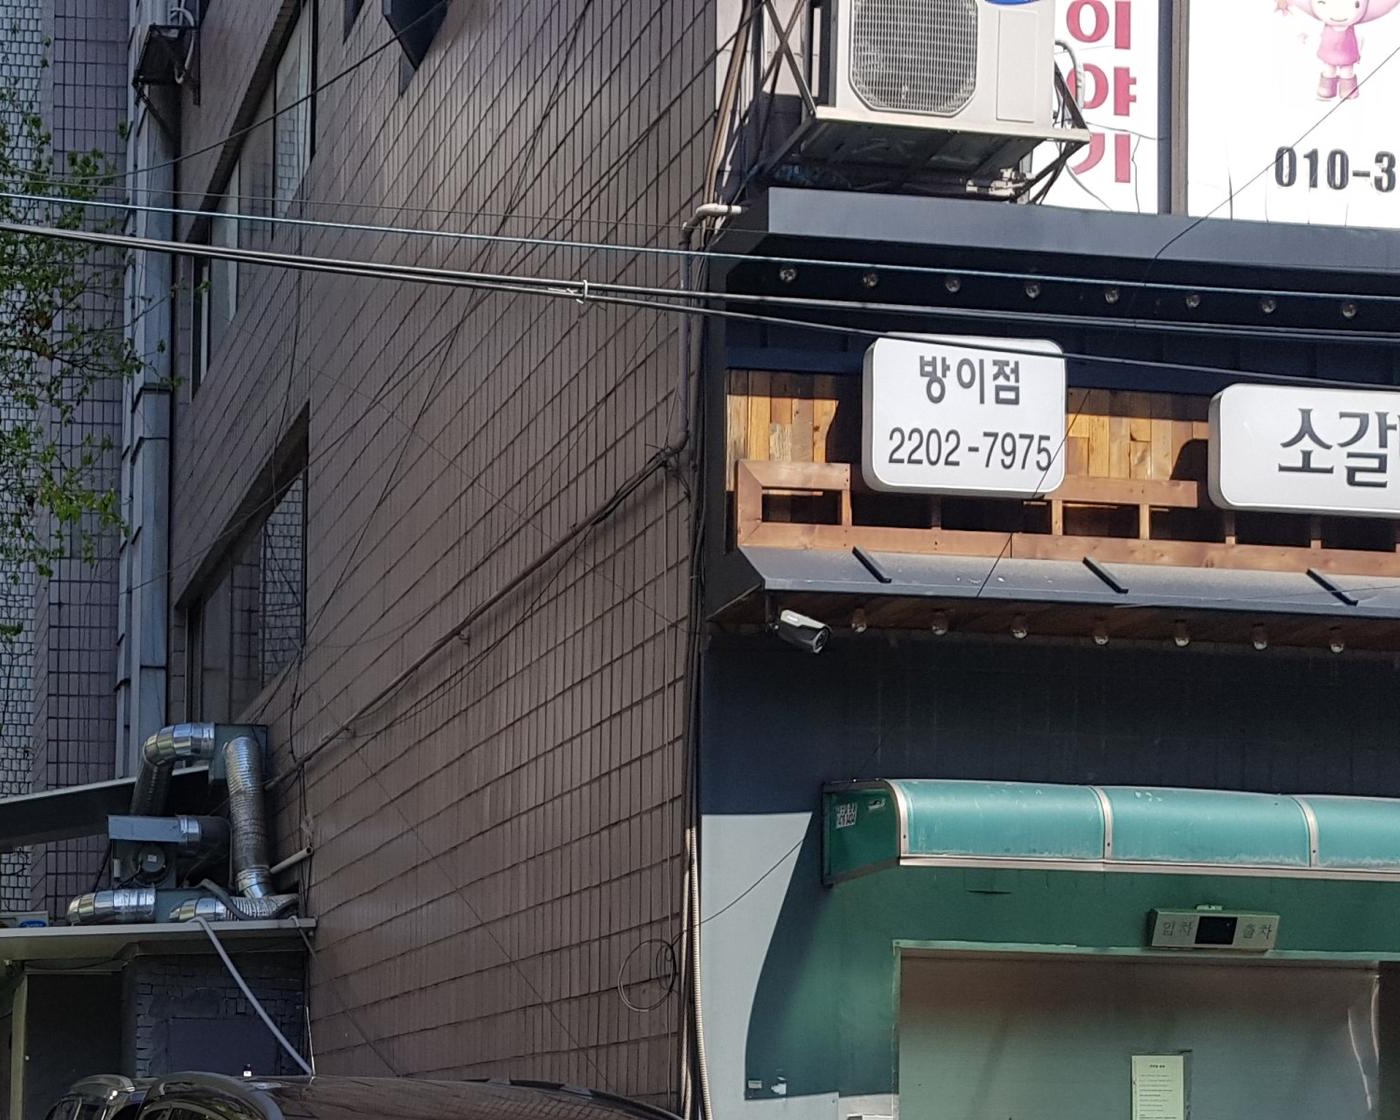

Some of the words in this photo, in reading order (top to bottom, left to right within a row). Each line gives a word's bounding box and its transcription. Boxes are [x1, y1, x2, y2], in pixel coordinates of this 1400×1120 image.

[919, 355, 1020, 406] 방이점
[888, 426, 1052, 472] 2202-7975
[1278, 407, 1400, 489] 소갈
